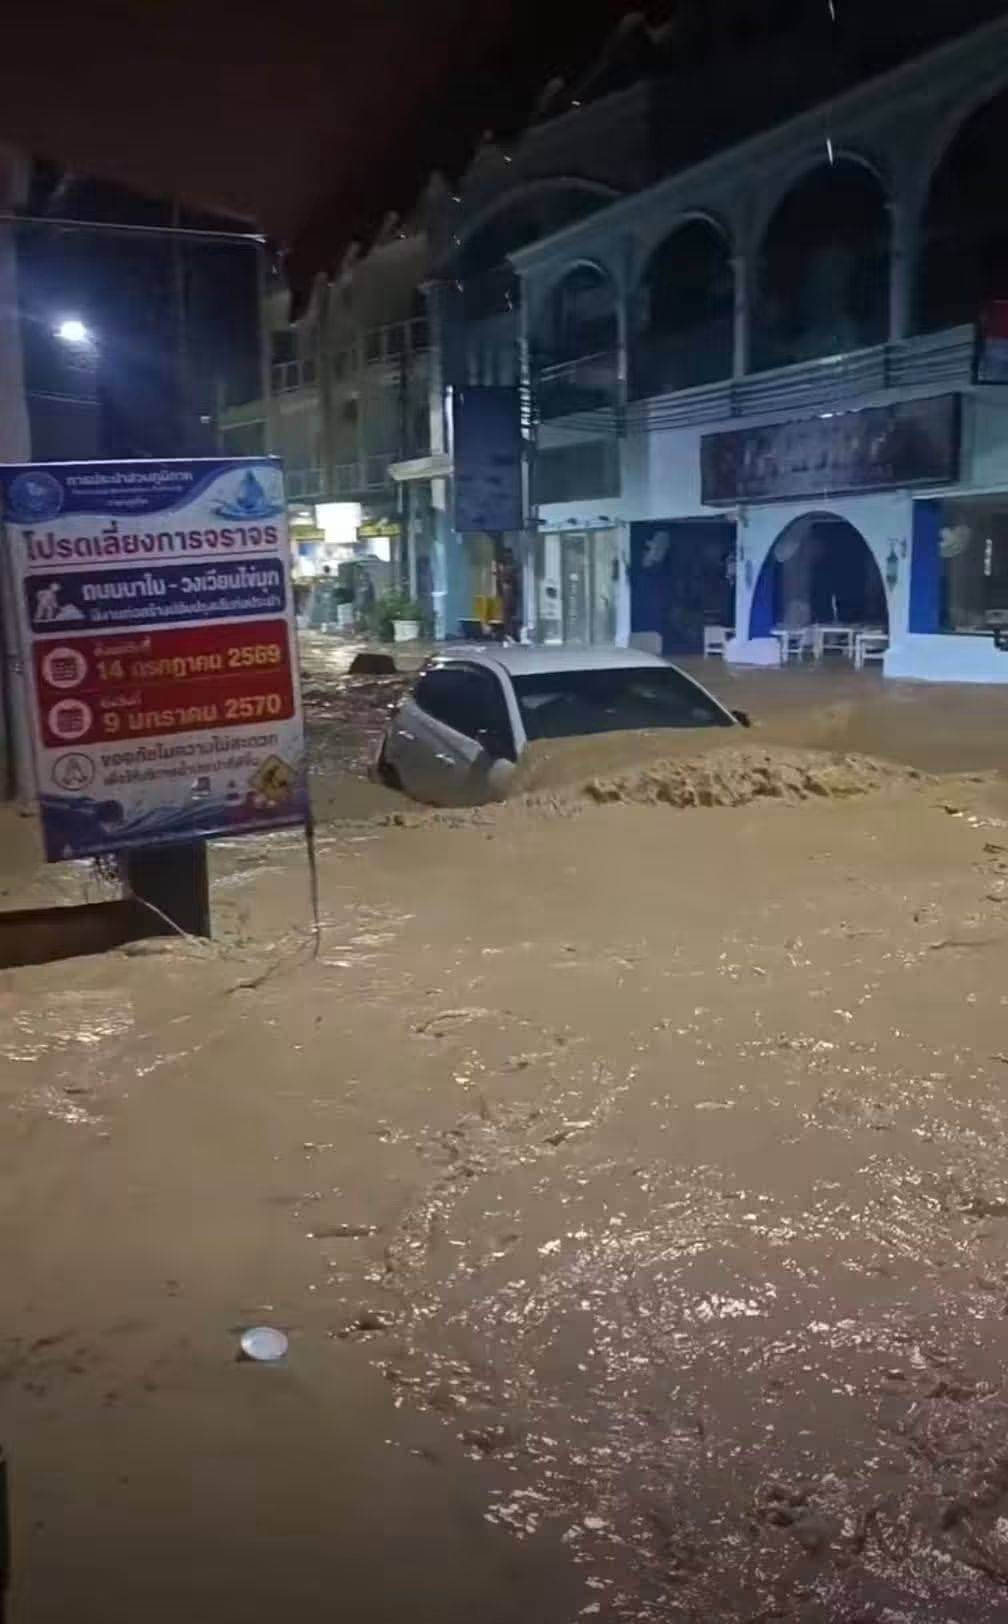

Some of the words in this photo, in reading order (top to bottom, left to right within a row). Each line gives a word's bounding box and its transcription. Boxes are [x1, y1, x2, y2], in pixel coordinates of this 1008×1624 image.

[24, 520, 278, 561] โปรดเลี่ยงการจราจร
[98, 659, 124, 680] 14
[131, 653, 222, 678] กรกฎาคม
[228, 644, 280, 668] 2569
[103, 711, 120, 733] 9
[129, 703, 217, 731] มกราคม
[224, 693, 282, 719] 2570
